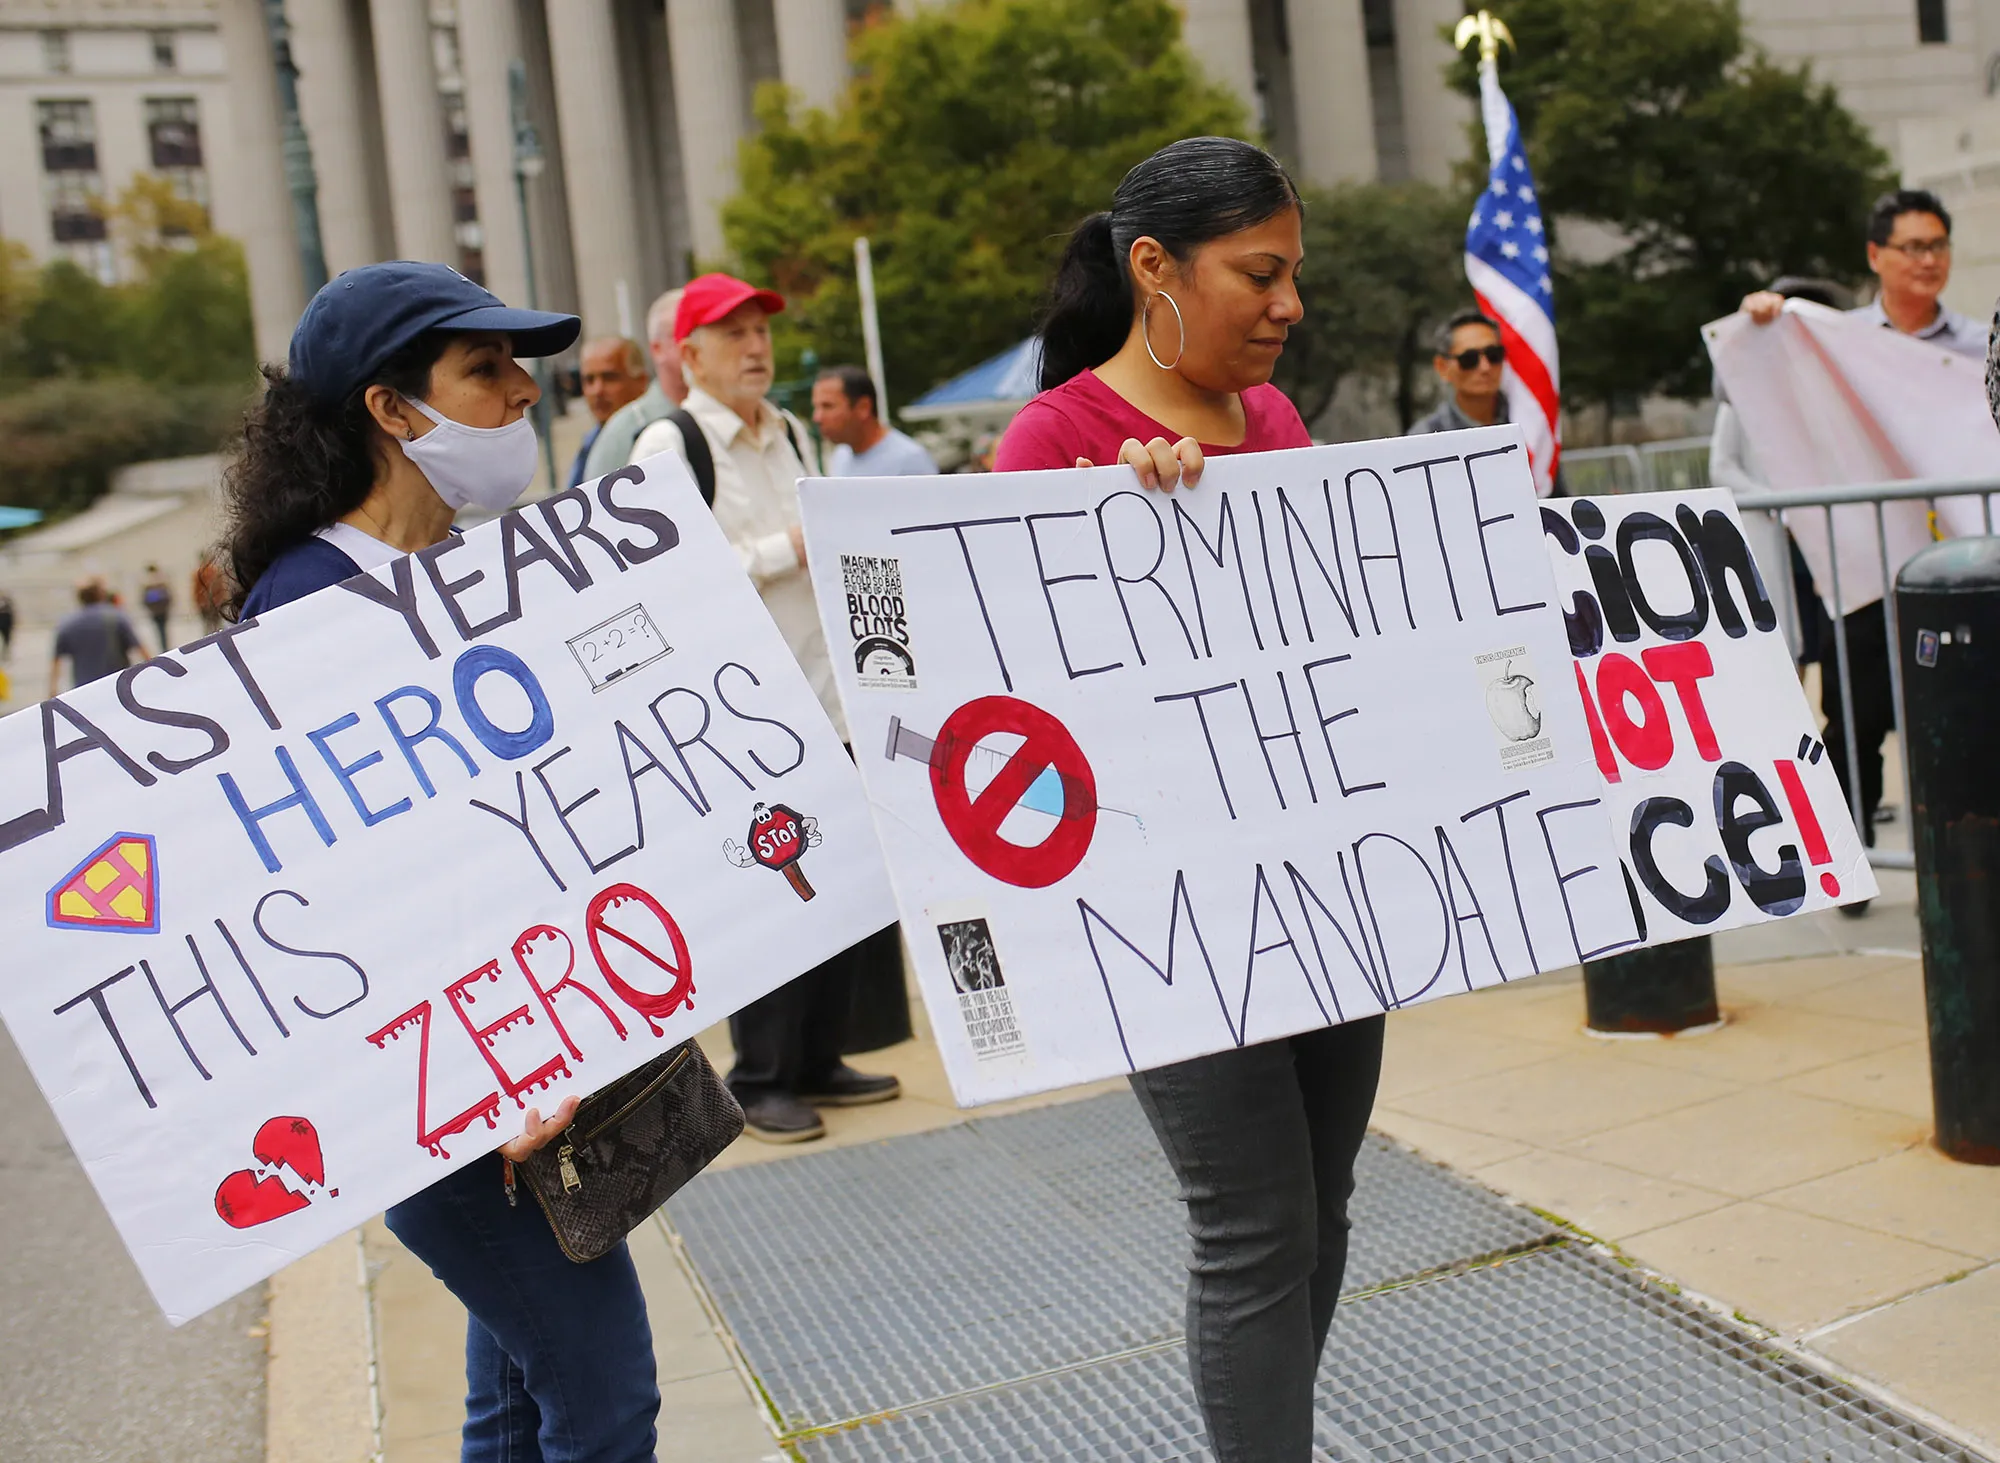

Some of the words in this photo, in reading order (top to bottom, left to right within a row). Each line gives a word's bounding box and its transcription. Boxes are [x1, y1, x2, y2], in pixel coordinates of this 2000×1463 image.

[840, 554, 879, 570] IMAGINE
[880, 558, 900, 571] NOT
[846, 593, 905, 618] BLOOD
[850, 574, 872, 587] COLD
[873, 576, 884, 587] SO
[884, 577, 902, 588] BAD
[850, 615, 909, 646] CLOTS
[880, 569, 901, 579] CATCH
[883, 586, 904, 597] WITH
[890, 444, 1548, 692] TERMINATE
[0, 617, 282, 852] AST
[338, 465, 680, 660] YEARS
[1573, 640, 1723, 784] OT
[217, 643, 557, 874] HERO
[469, 662, 806, 892] YEARS
[1154, 654, 1387, 820] THE
[757, 820, 799, 859] STOP
[54, 890, 370, 1109] THIS
[1076, 791, 1642, 1073] MANDATE
[365, 882, 697, 1161] ZERO
